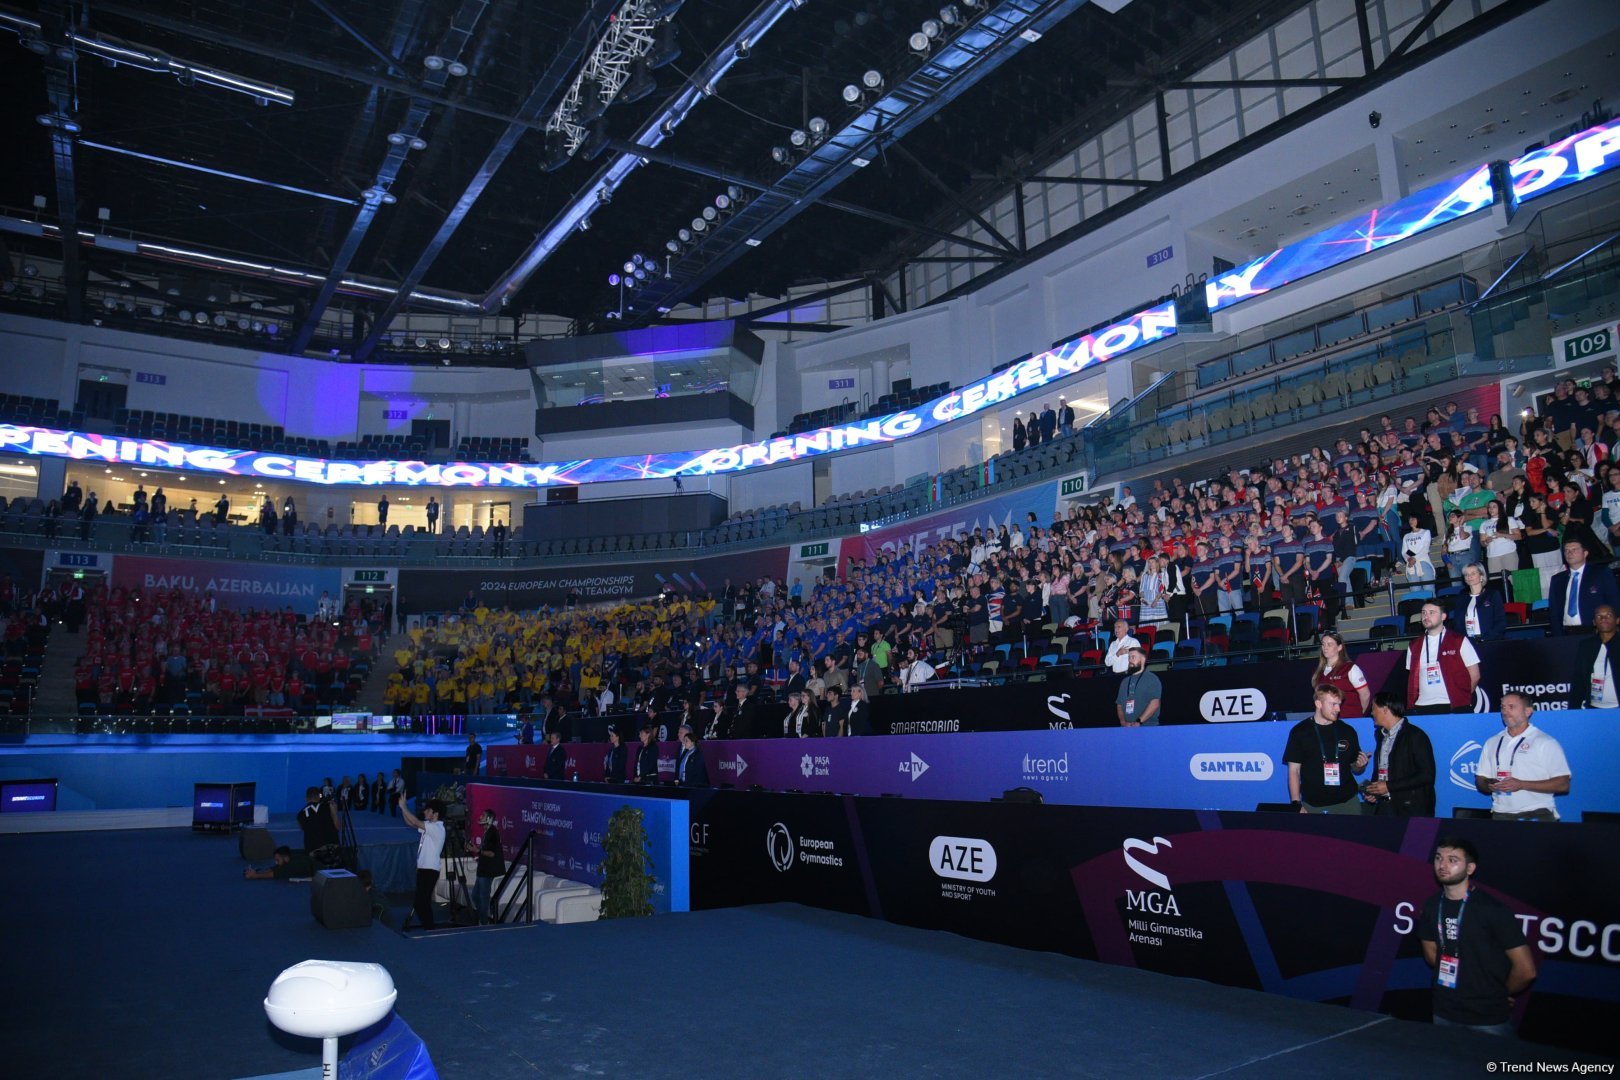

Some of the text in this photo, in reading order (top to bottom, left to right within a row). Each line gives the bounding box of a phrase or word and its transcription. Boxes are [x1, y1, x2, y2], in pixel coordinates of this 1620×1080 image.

[1152, 249, 1169, 265] 310
[1569, 334, 1607, 358] 109
[143, 373, 160, 384] 313
[834, 380, 849, 388] 311
[699, 412, 922, 471] OPENING
[252, 456, 559, 485] CEREMONY
[1063, 479, 1083, 493] 110
[807, 545, 823, 556] 111
[69, 555, 89, 565] 113
[362, 570, 379, 581] 112
[144, 573, 314, 597] BAKU, AZERBAIJAN
[480, 576, 635, 591] 2024 EUROPEAN CHAMPIONSHIPS
[585, 585, 633, 596] TEAMGYM
[1211, 695, 1254, 717] AZE
[890, 719, 960, 735] SMARTSCORING
[899, 761, 923, 772] AZ TV
[1025, 752, 1068, 773] trend
[1200, 760, 1262, 773] SANTRAL
[814, 767, 830, 776] Bank
[302, 802, 321, 819] TV
[521, 809, 547, 825] TEAMGYM
[799, 836, 834, 851] European
[799, 851, 843, 867] Gymnastics
[940, 844, 984, 875] AZE
[941, 882, 996, 897] MINISTRY OF YOUTH
[941, 891, 972, 901] AND SPORT
[1125, 889, 1182, 917] MGA
[1128, 919, 1203, 940] Milli Gimnastika
[1129, 932, 1163, 947] Arenası
